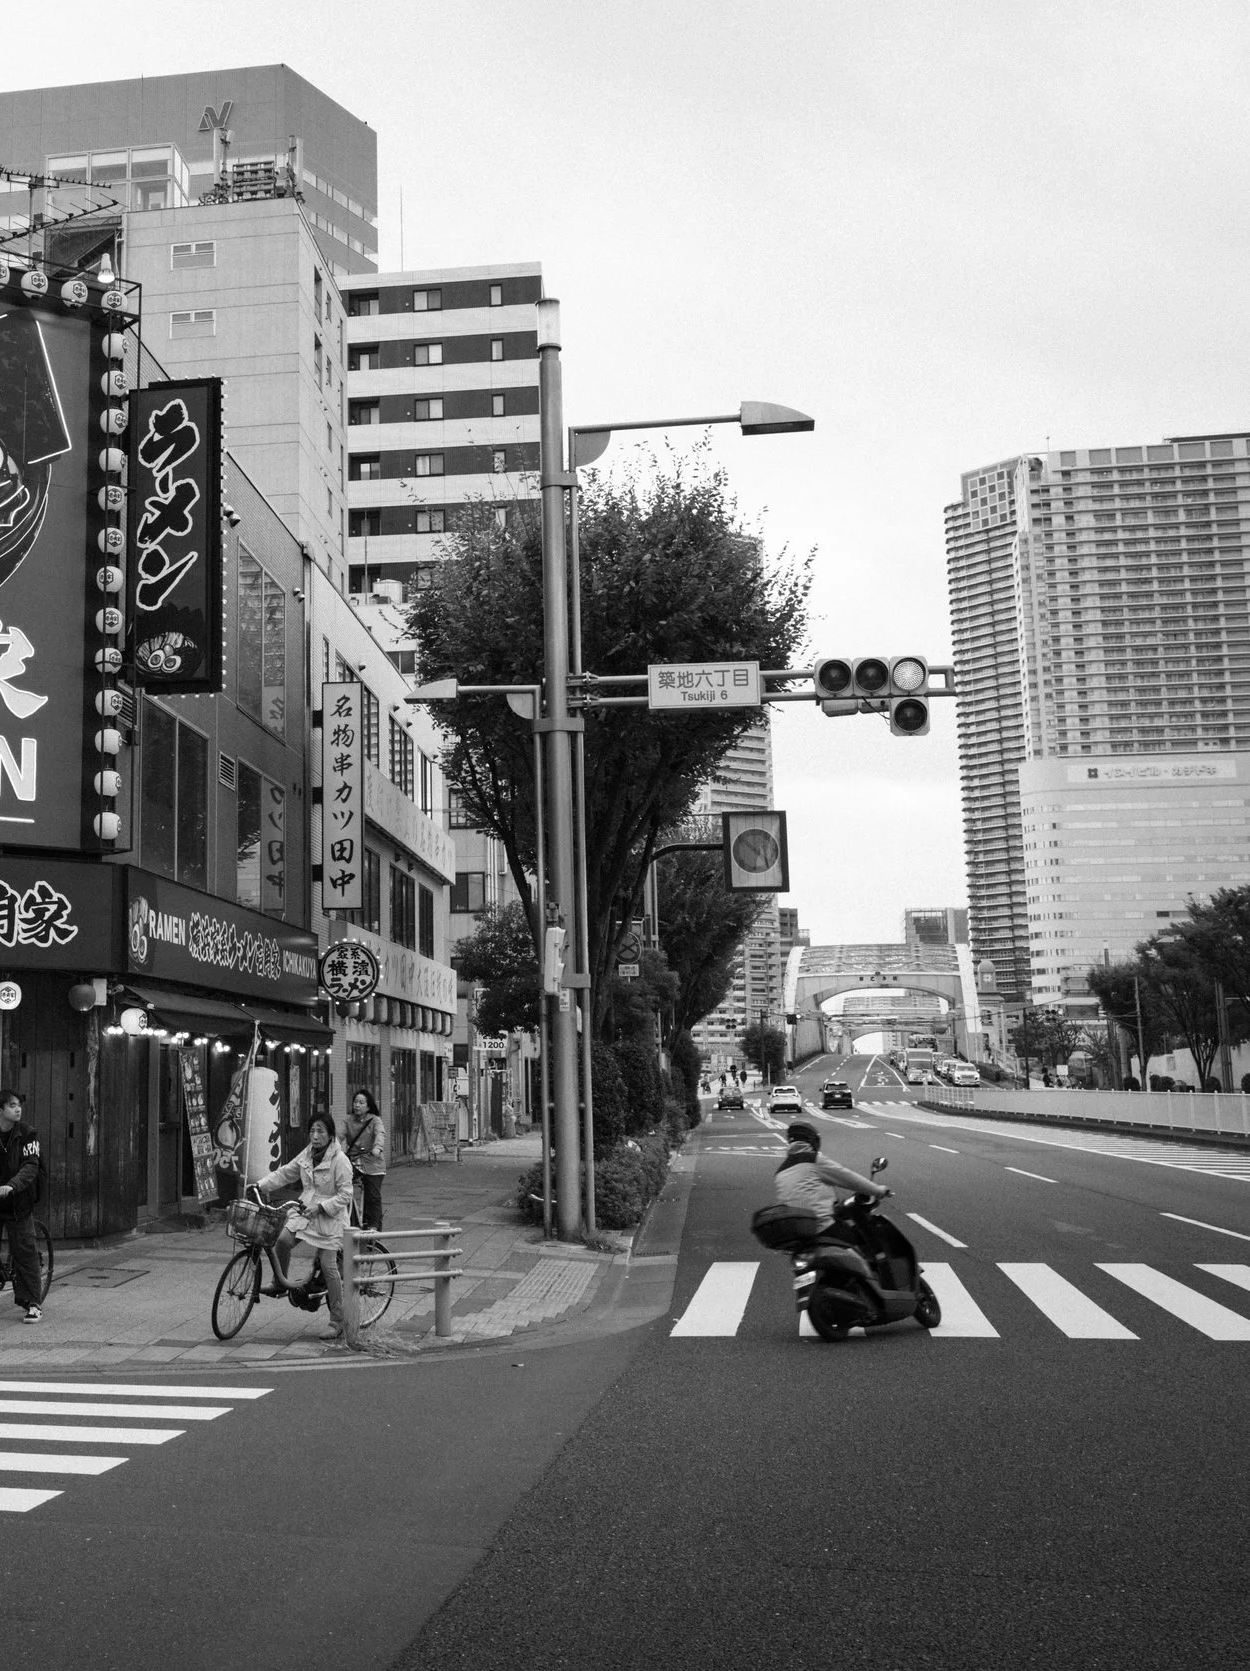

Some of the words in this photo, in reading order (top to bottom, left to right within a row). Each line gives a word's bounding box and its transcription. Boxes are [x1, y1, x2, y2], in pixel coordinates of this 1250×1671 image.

[658, 669, 749, 689] 築地六丁目
[681, 690, 715, 702] Tsukiji
[720, 690, 728, 700] 6
[329, 694, 356, 897] 名物串カツ田中
[150, 909, 186, 946] RAMEN
[336, 946, 361, 960] 家系
[283, 950, 317, 980] ICHIKAKUYA
[483, 1041, 504, 1049] 1200
